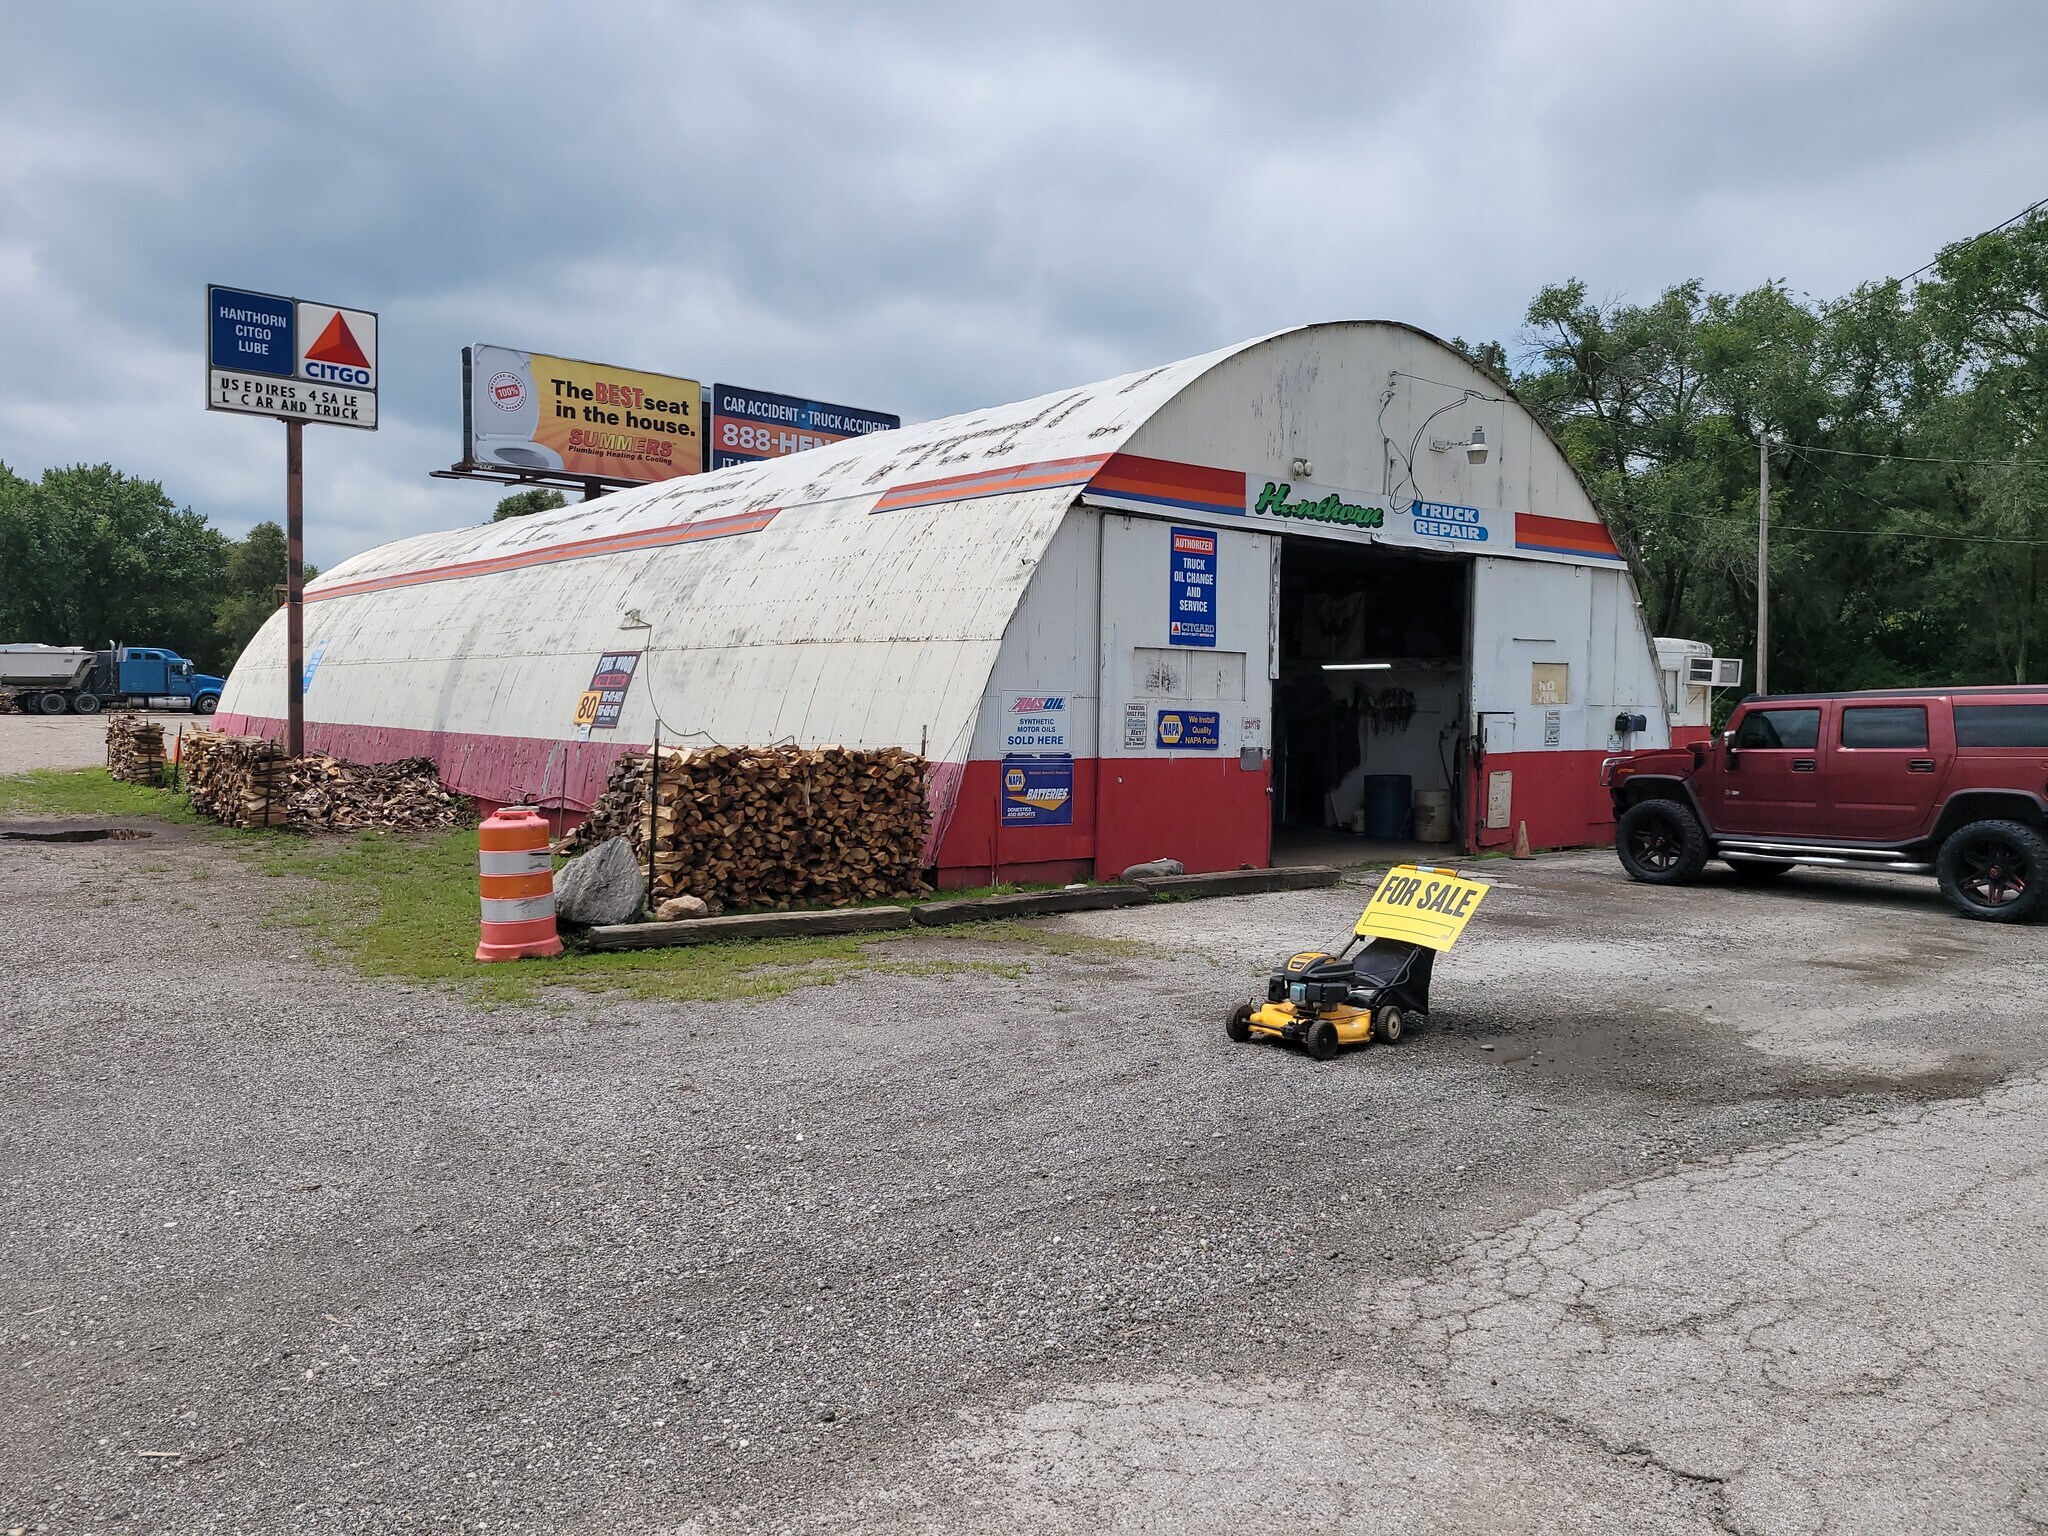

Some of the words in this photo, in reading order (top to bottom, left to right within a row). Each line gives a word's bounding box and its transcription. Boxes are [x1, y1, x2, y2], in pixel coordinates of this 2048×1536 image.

[220, 306, 286, 328] HANTHORN
[236, 325, 272, 340] CITGO
[238, 340, 269, 355] LUBE
[306, 362, 370, 384] CITGO
[309, 391, 316, 401] 4
[497, 386, 518, 397] 100%
[550, 379, 594, 400] The
[595, 382, 644, 409] BEST
[644, 398, 689, 416] seat
[223, 392, 229, 403] L
[282, 400, 307, 412] AND
[315, 404, 358, 420] TRUCK
[723, 396, 745, 414] CAR
[747, 400, 799, 422] ACCIDENT
[808, 410, 841, 430] TRUCK
[556, 401, 576, 419] in
[583, 405, 620, 426] the
[626, 410, 696, 436] house.
[568, 428, 673, 457] SUMMERS
[568, 445, 604, 458] Plumbing
[606, 450, 635, 460] Heating
[645, 455, 672, 465] Cooling
[1420, 503, 1477, 522] TRUCK
[1416, 522, 1480, 540] REPAIR
[1175, 537, 1213, 551] AUTHORIZED
[1183, 557, 1205, 570] TRUCK
[1174, 571, 1185, 582] OIL
[1186, 572, 1213, 585] CHANGE
[1186, 586, 1201, 598] AND
[1180, 599, 1208, 612] SERVICE
[1181, 622, 1214, 633] CITGARD
[596, 656, 617, 675] FIRE
[615, 656, 636, 674] WOOD
[596, 676, 608, 685] FOR
[609, 676, 625, 685] SALE
[1539, 680, 1555, 691] NO
[1010, 697, 1066, 712] AMSOIL
[1163, 723, 1179, 736] NAPA
[1192, 726, 1212, 735] Quality
[1008, 736, 1034, 745] SOLD
[1038, 736, 1063, 744] HERE
[1008, 775, 1022, 785] NAPA
[1026, 788, 1068, 800] BATTERIES
[1376, 876, 1422, 906] FOR
[1417, 881, 1477, 918] SALE
